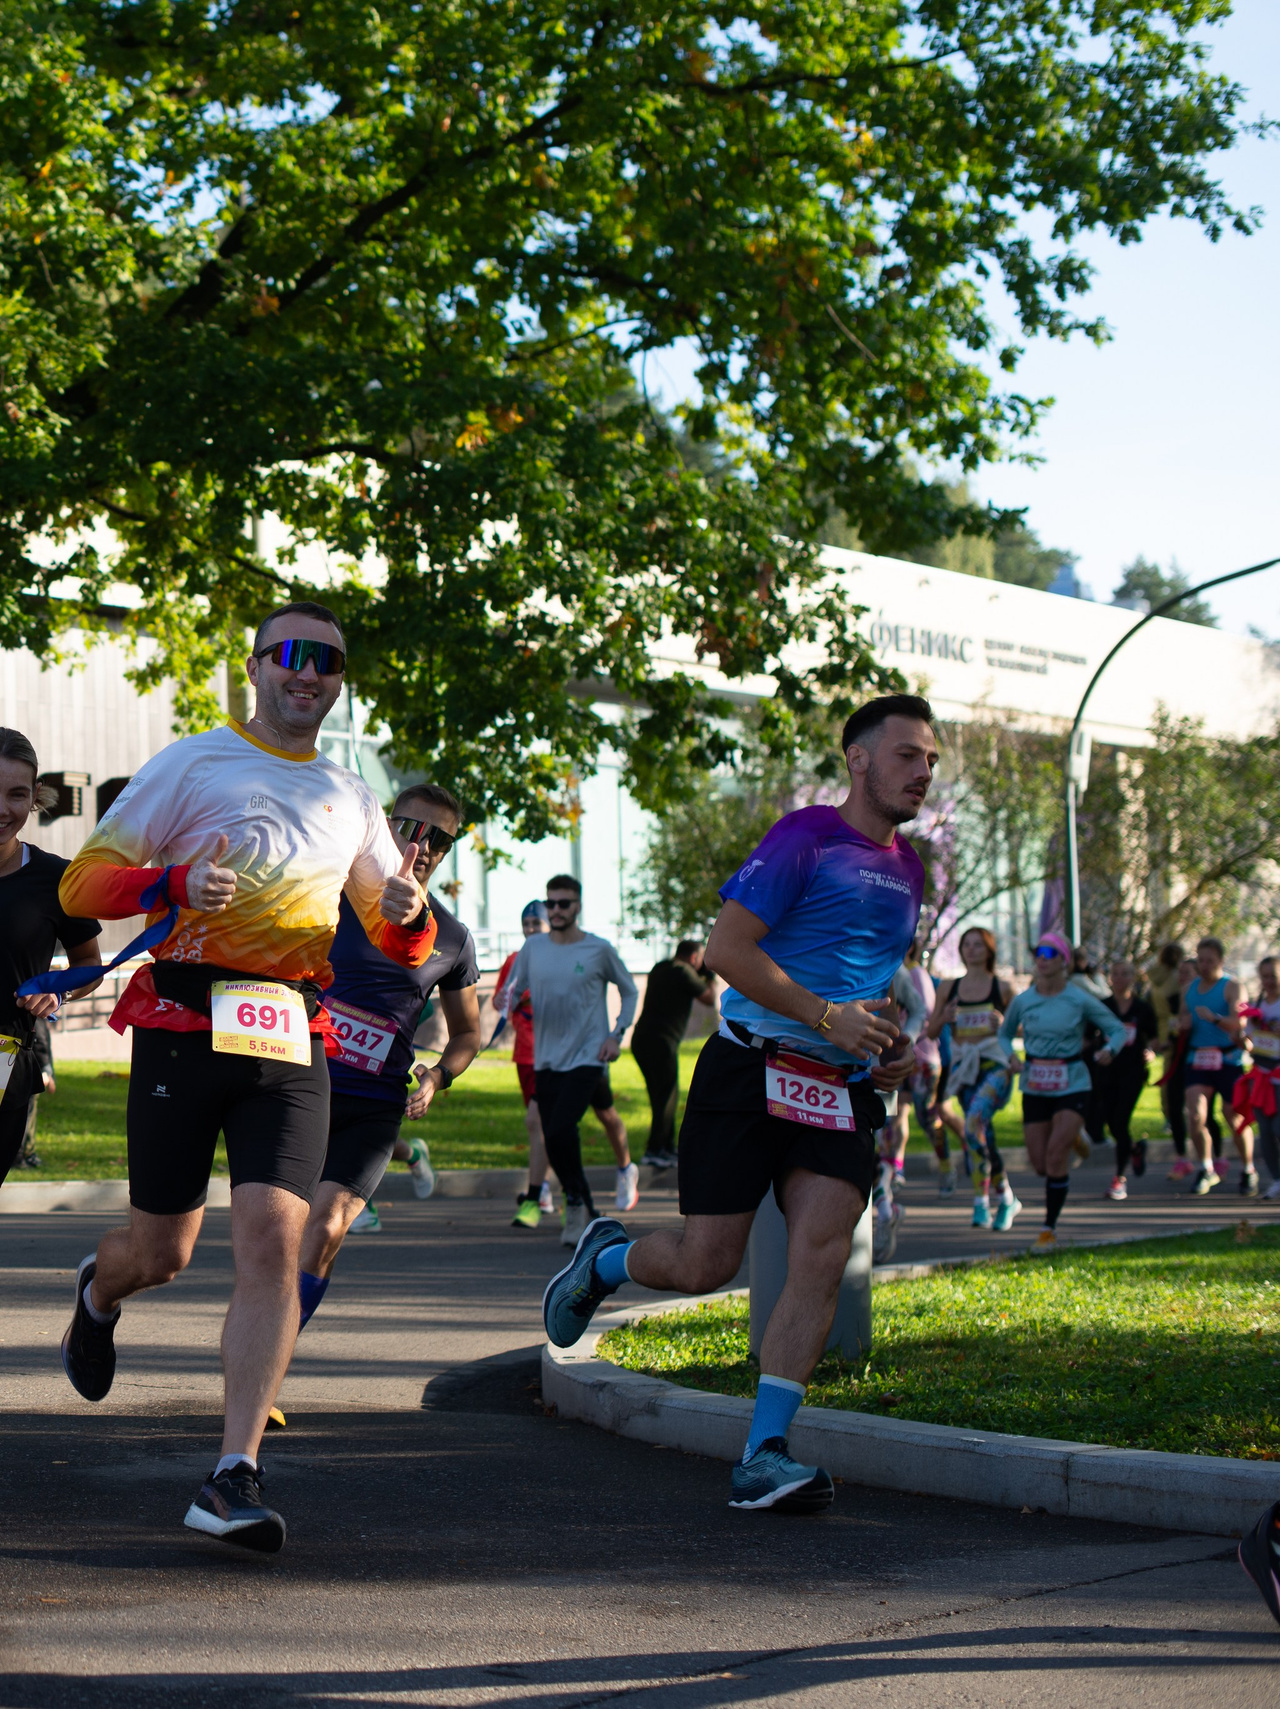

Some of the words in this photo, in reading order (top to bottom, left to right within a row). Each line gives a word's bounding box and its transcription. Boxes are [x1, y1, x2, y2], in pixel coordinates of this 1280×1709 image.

[870, 608, 974, 664] ФЕНИКС
[224, 984, 280, 995] ИНКЛЮЗИВНЫЙ
[236, 1002, 290, 1034] 691
[249, 1040, 268, 1054] 5,5
[776, 1076, 839, 1110] 1262
[796, 1111, 808, 1121] 11
